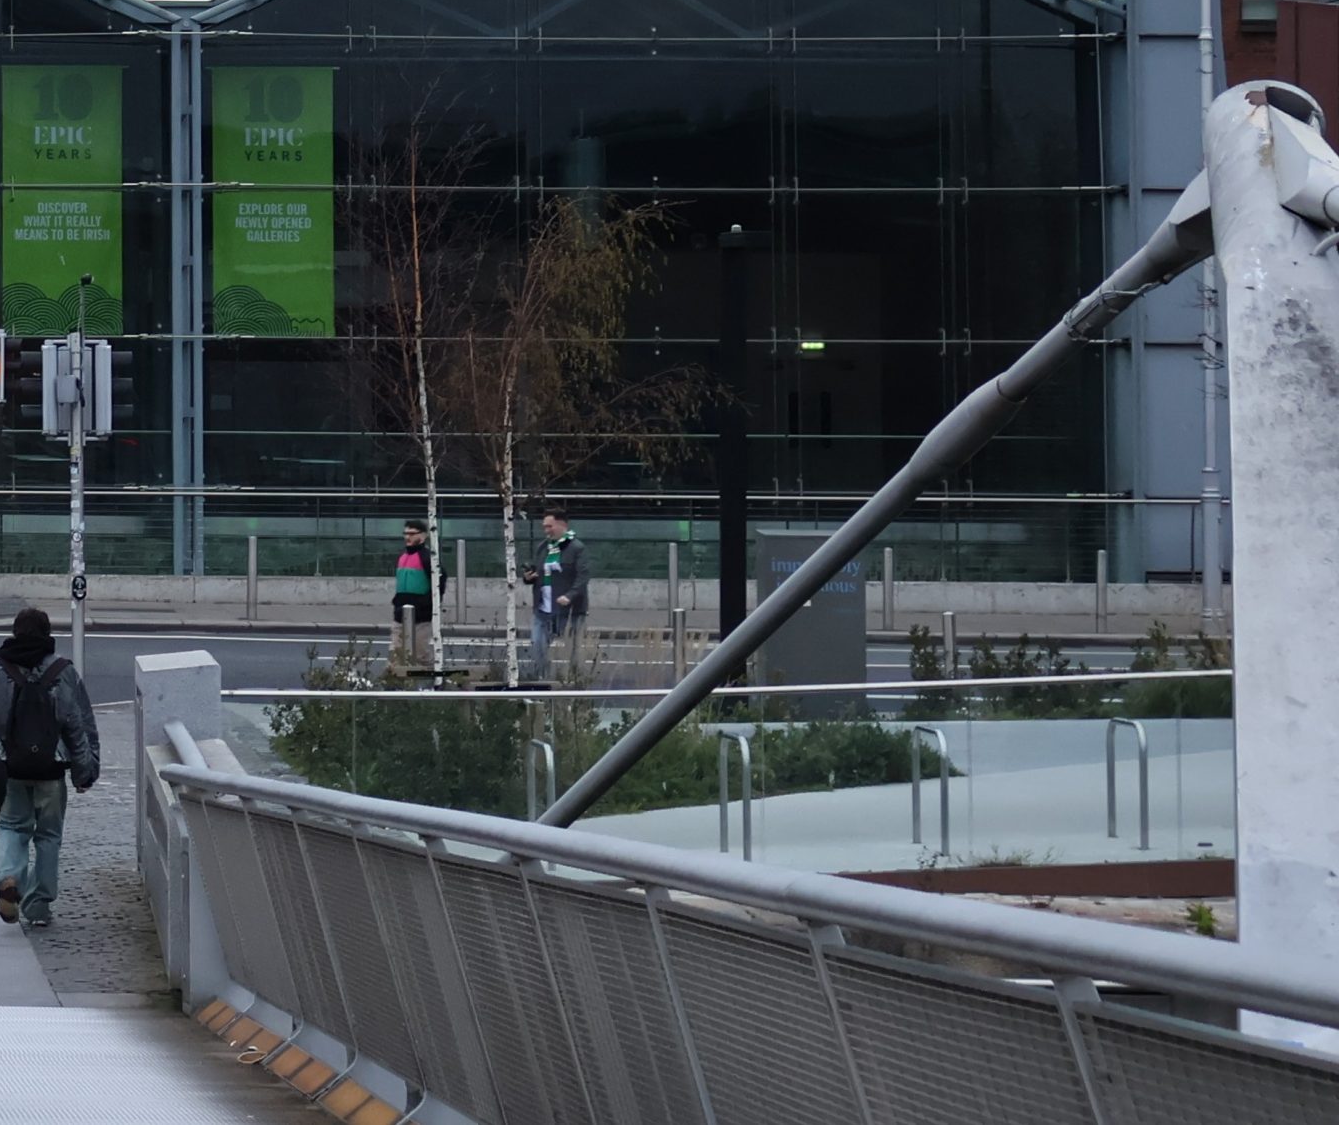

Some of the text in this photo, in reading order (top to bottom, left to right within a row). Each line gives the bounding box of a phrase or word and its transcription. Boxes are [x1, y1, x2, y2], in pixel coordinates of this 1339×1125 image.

[33, 73, 93, 120] 10
[243, 75, 303, 123] 10
[34, 126, 92, 145] EPIC
[244, 127, 303, 146] EPIC
[34, 148, 92, 160] YEARS
[244, 150, 303, 162] YEARS
[37, 202, 87, 213] DISCOVER
[239, 203, 307, 215] EXPLORE OUR
[24, 216, 101, 227] WHAT IT REALLY
[235, 217, 311, 229] NEWLY OPENED
[14, 229, 111, 241] MEANS TO BE IRISH
[247, 230, 300, 242] GALLERIES
